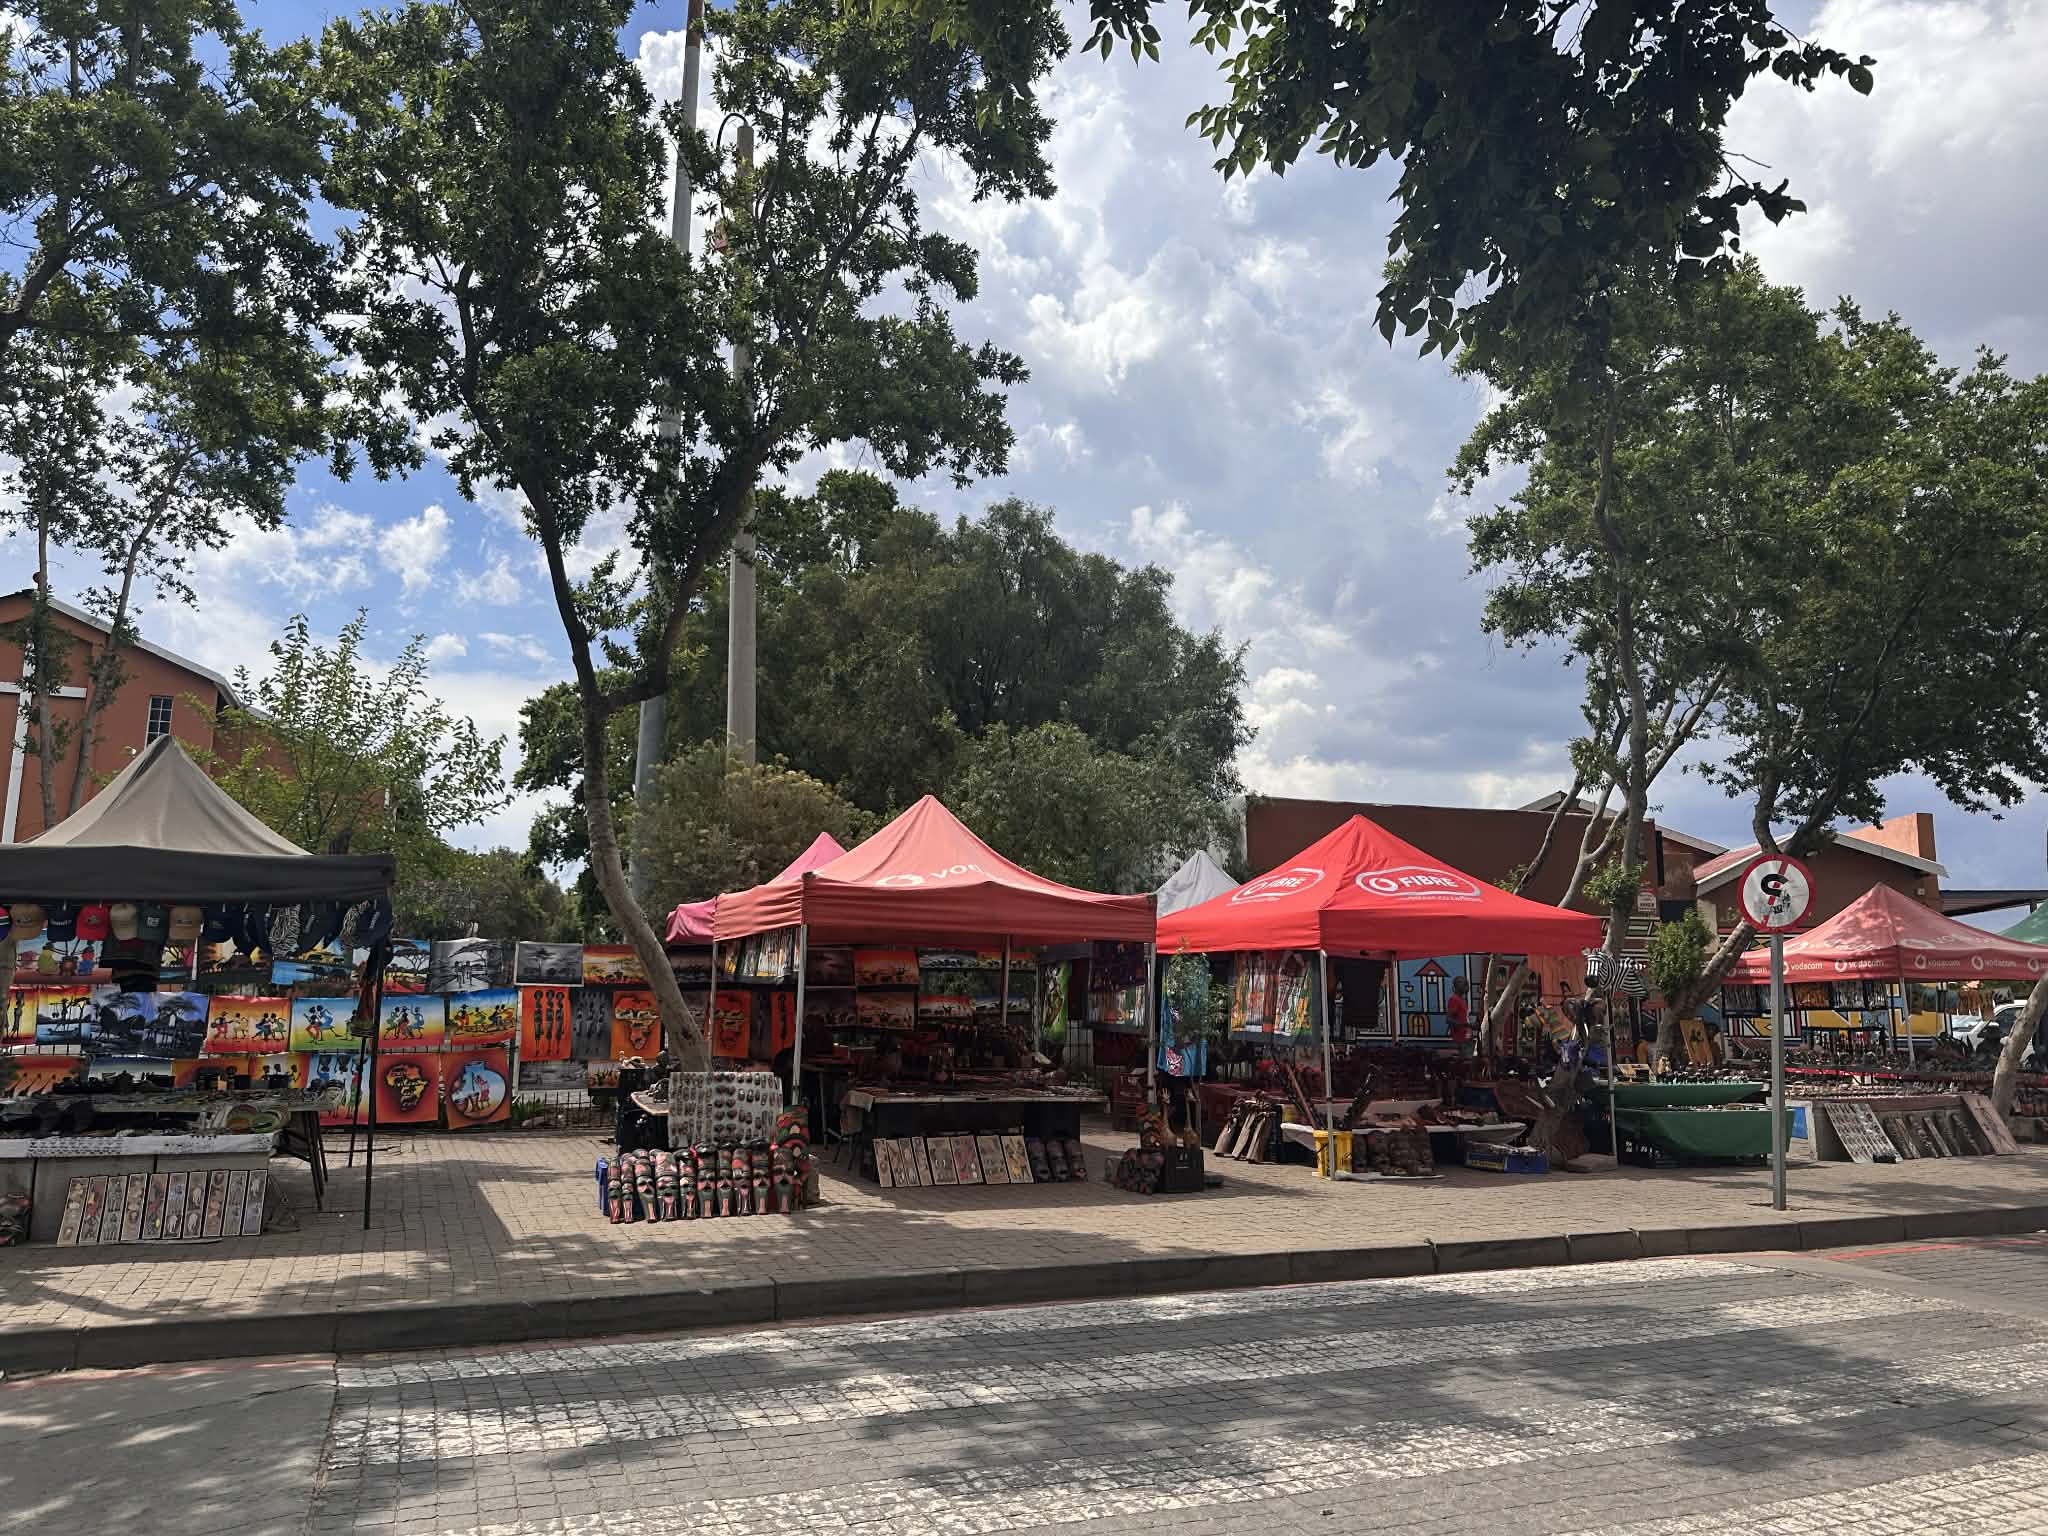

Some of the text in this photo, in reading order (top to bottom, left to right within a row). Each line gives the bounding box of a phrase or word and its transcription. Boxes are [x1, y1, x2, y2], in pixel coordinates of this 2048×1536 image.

[1398, 875, 1459, 887] FIBRE
[1791, 962, 1823, 971] vodacom
[1849, 958, 1884, 968] vodacom
